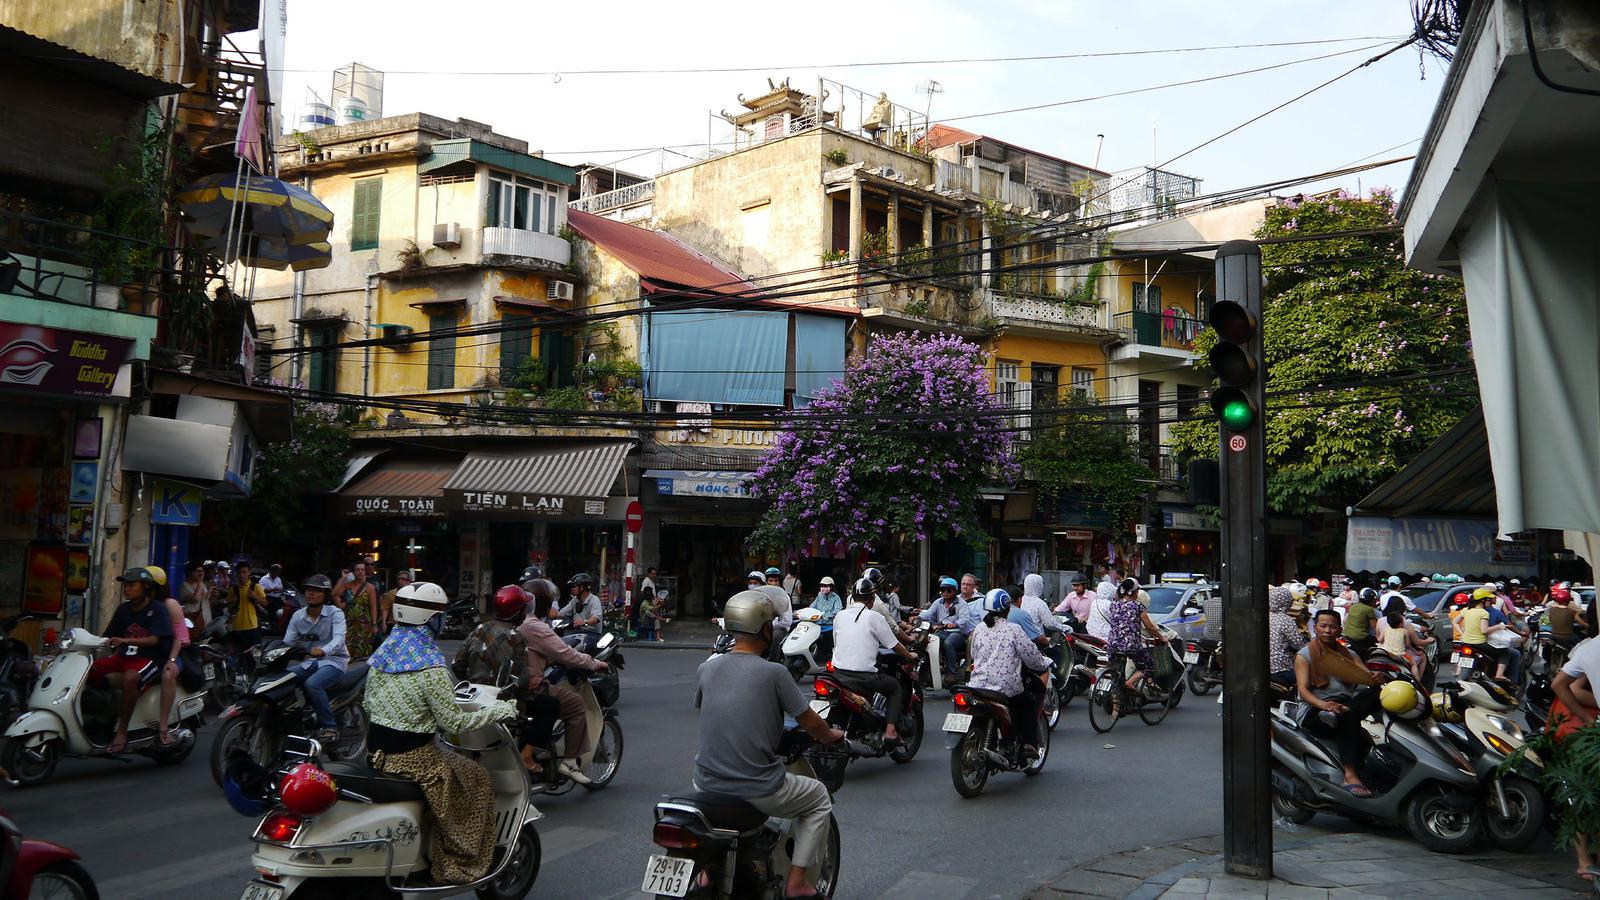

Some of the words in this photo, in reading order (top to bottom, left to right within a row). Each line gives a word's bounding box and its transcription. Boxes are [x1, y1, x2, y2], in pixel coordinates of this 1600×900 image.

[69, 340, 108, 360] Buddha
[77, 365, 115, 389] Gallery
[1231, 438, 1245, 449] 60
[160, 487, 192, 517] K
[356, 496, 389, 509] QUỐC
[522, 496, 564, 509] LAN
[649, 875, 682, 893] 7103
